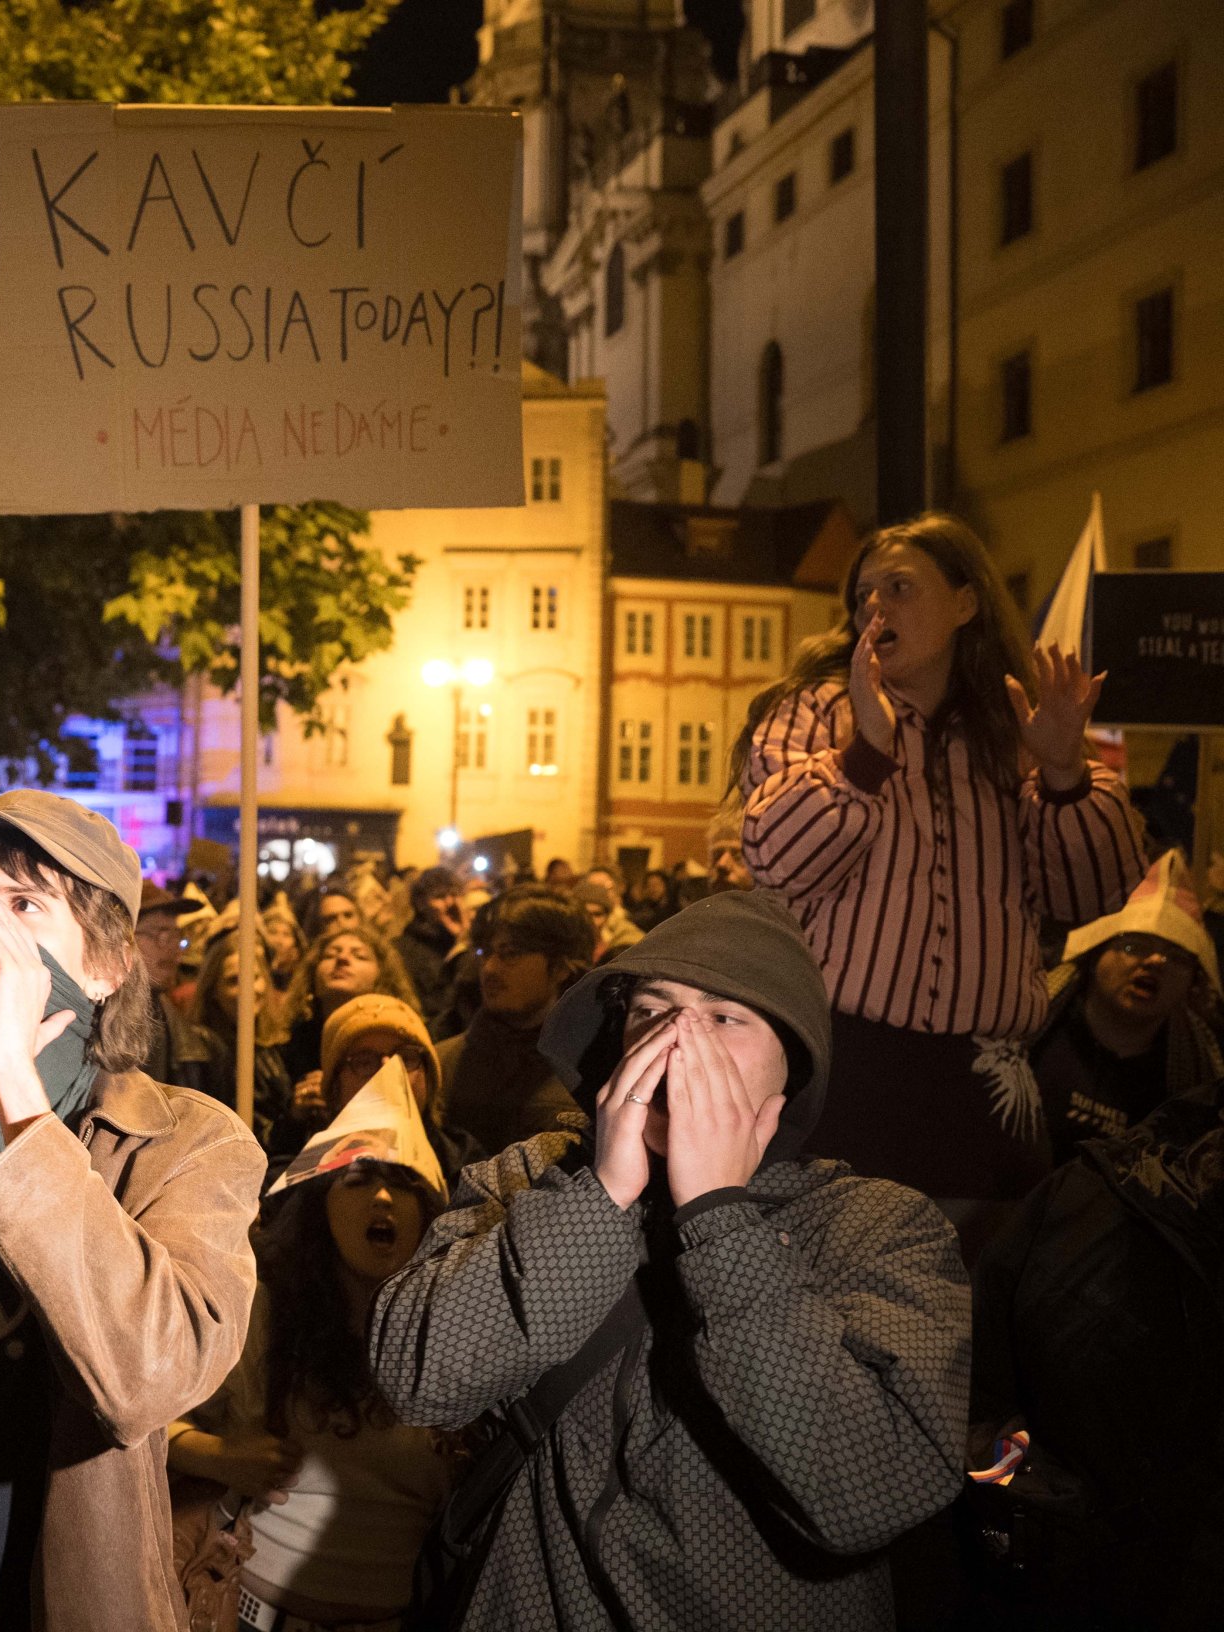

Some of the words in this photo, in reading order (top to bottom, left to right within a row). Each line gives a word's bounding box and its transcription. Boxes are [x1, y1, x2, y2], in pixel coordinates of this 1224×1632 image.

[32, 138, 405, 270] KAVČÍ
[57, 283, 321, 381] RUSSIA
[329, 280, 506, 378] TODAY?!
[133, 396, 263, 472] MÉDIA
[282, 402, 432, 458] NEDÁME
